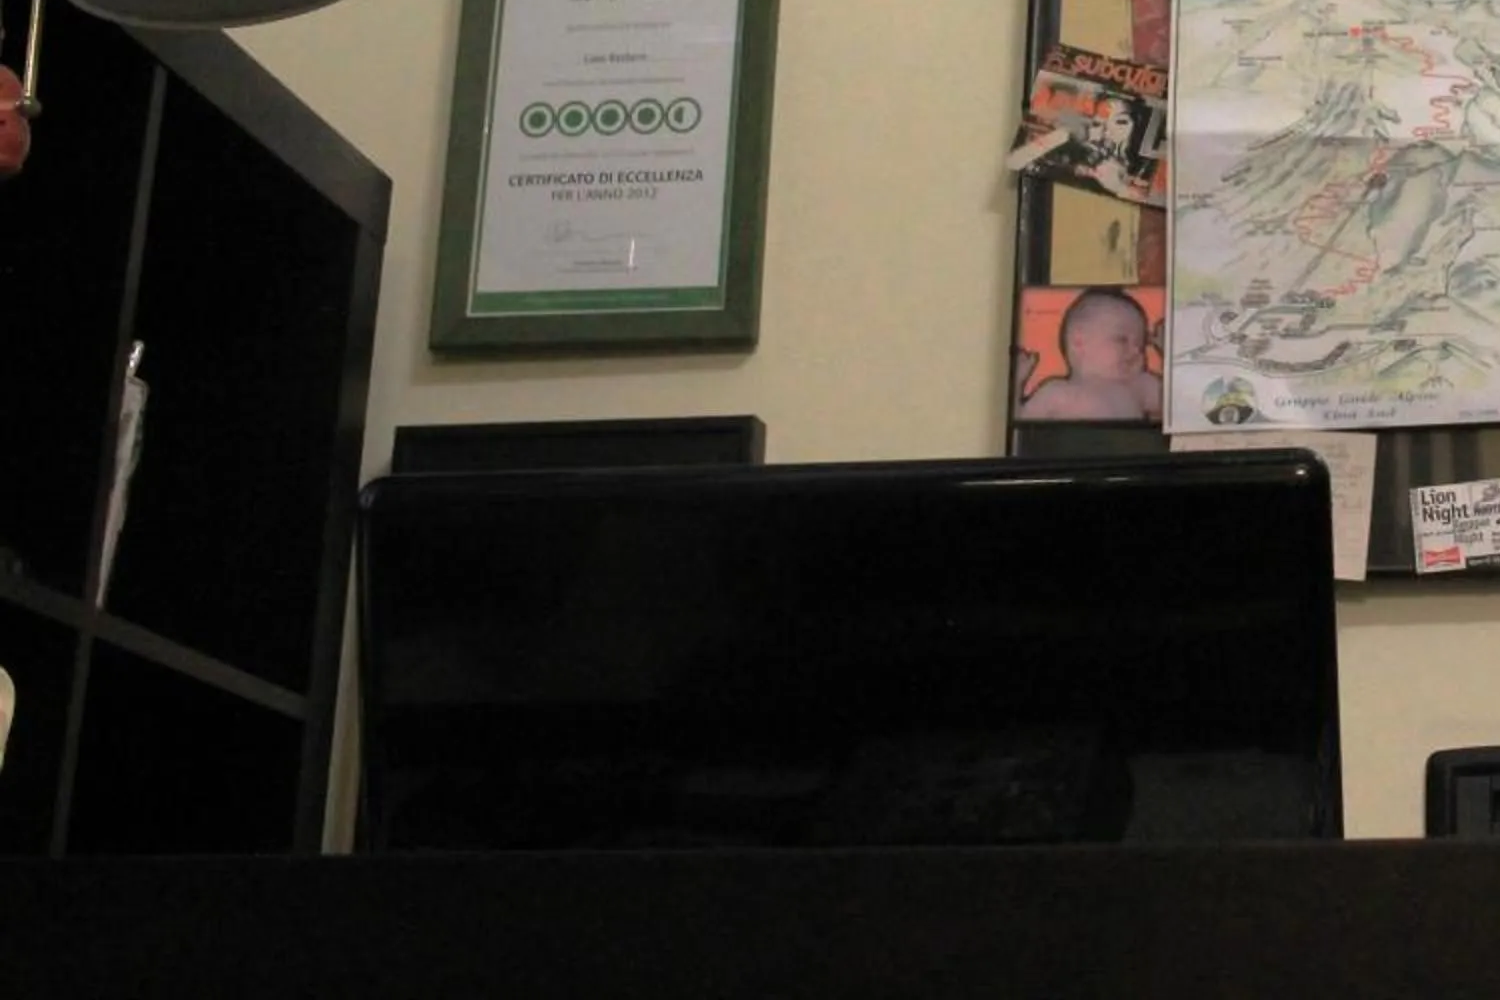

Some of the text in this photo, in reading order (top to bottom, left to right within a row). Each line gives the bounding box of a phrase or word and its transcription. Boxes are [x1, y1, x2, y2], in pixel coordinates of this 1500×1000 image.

[508, 169, 704, 187] CERTIFICATO DI ECCELLENZA
[551, 189, 573, 202] PER
[577, 187, 624, 201] L'ANNO
[1420, 488, 1456, 506] Lion
[1422, 503, 1471, 525] Night
